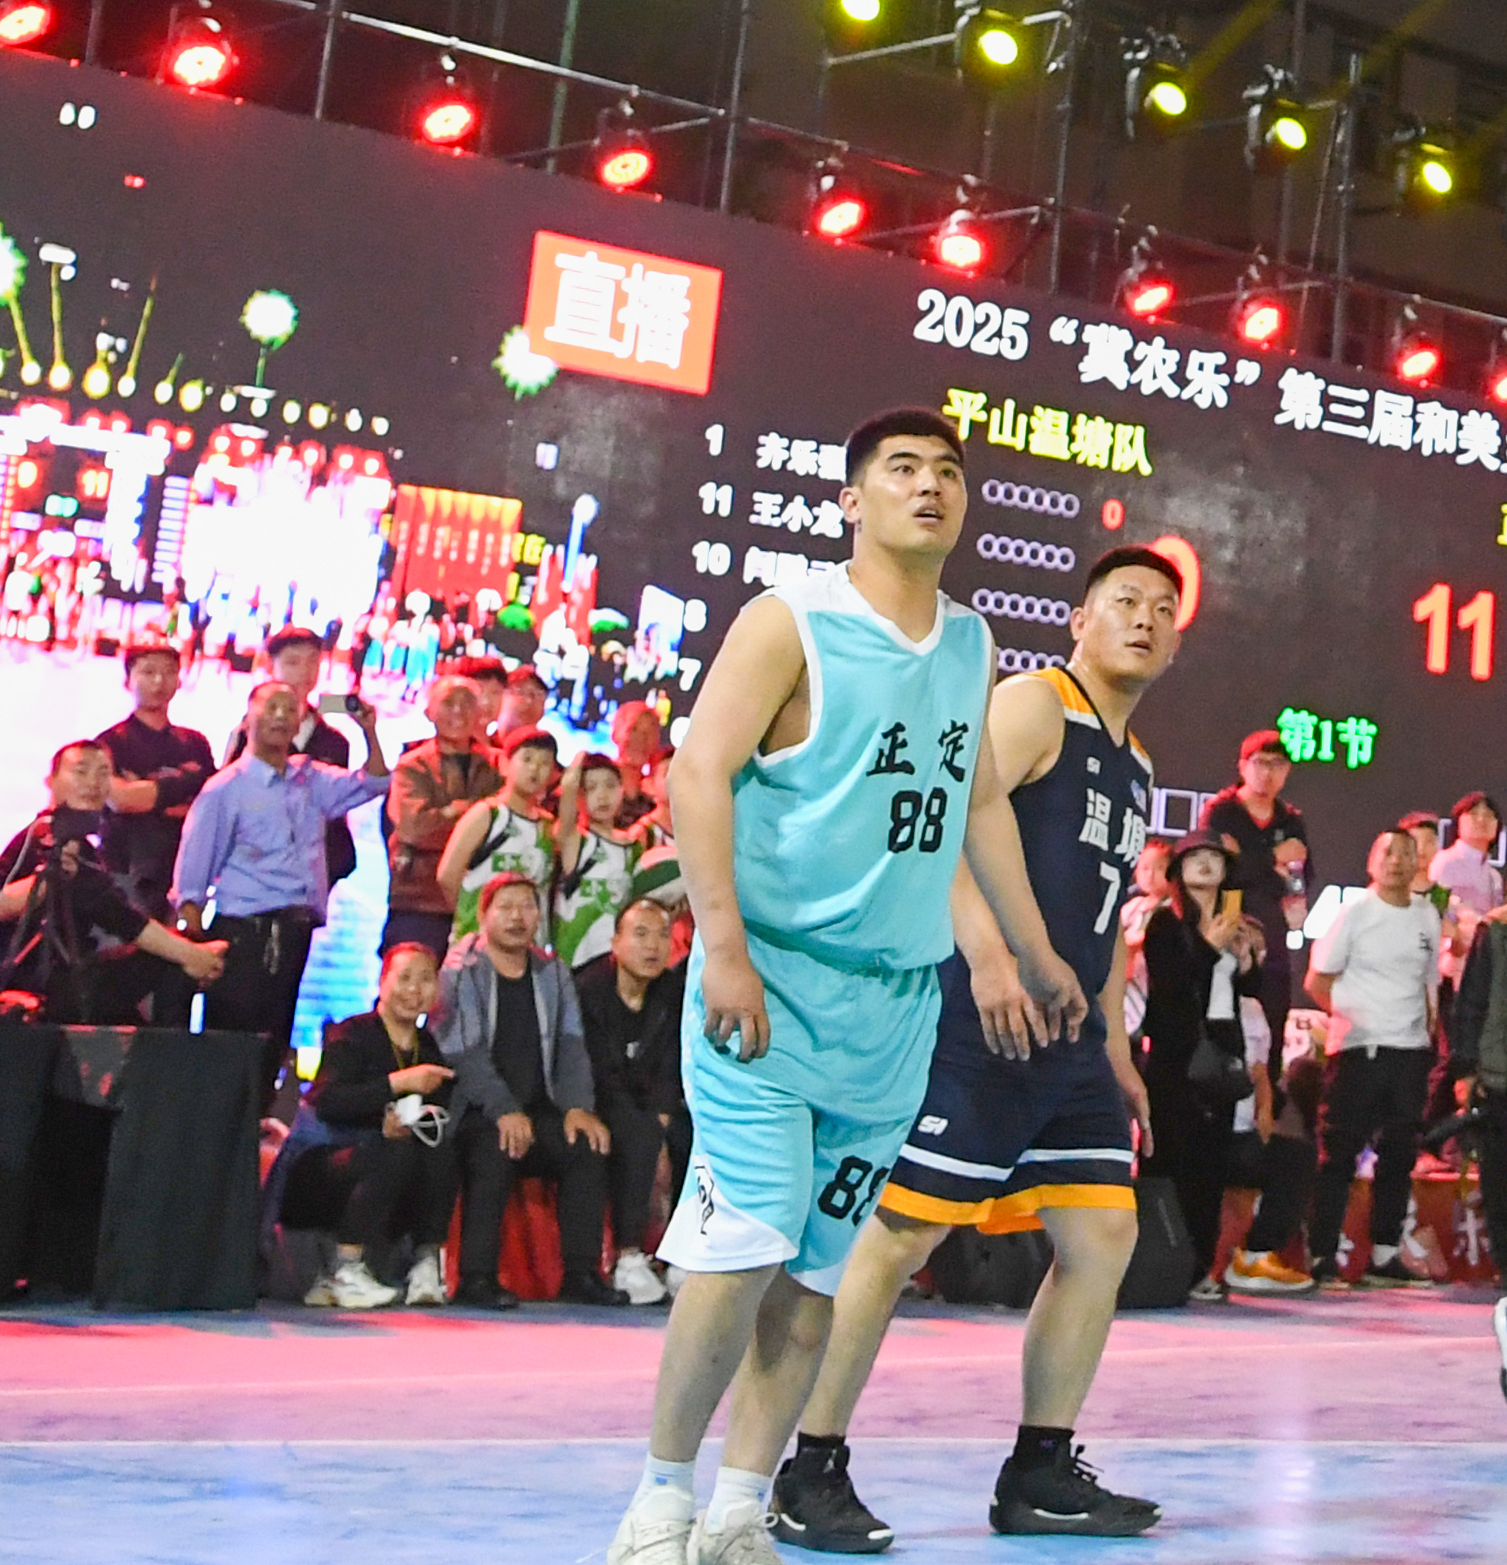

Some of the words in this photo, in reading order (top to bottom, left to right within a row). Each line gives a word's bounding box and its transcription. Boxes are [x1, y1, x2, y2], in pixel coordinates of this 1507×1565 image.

[543, 250, 692, 370] 直播
[705, 424, 724, 457] 1
[941, 388, 1153, 477] 平山温塘队
[699, 482, 734, 517] 11
[691, 540, 731, 576] 10
[1413, 582, 1495, 681] 11
[678, 657, 702, 692] 7
[866, 721, 969, 784] 正定
[1276, 706, 1379, 770] 第1节
[887, 787, 948, 854] 88
[1093, 861, 1121, 935] 7
